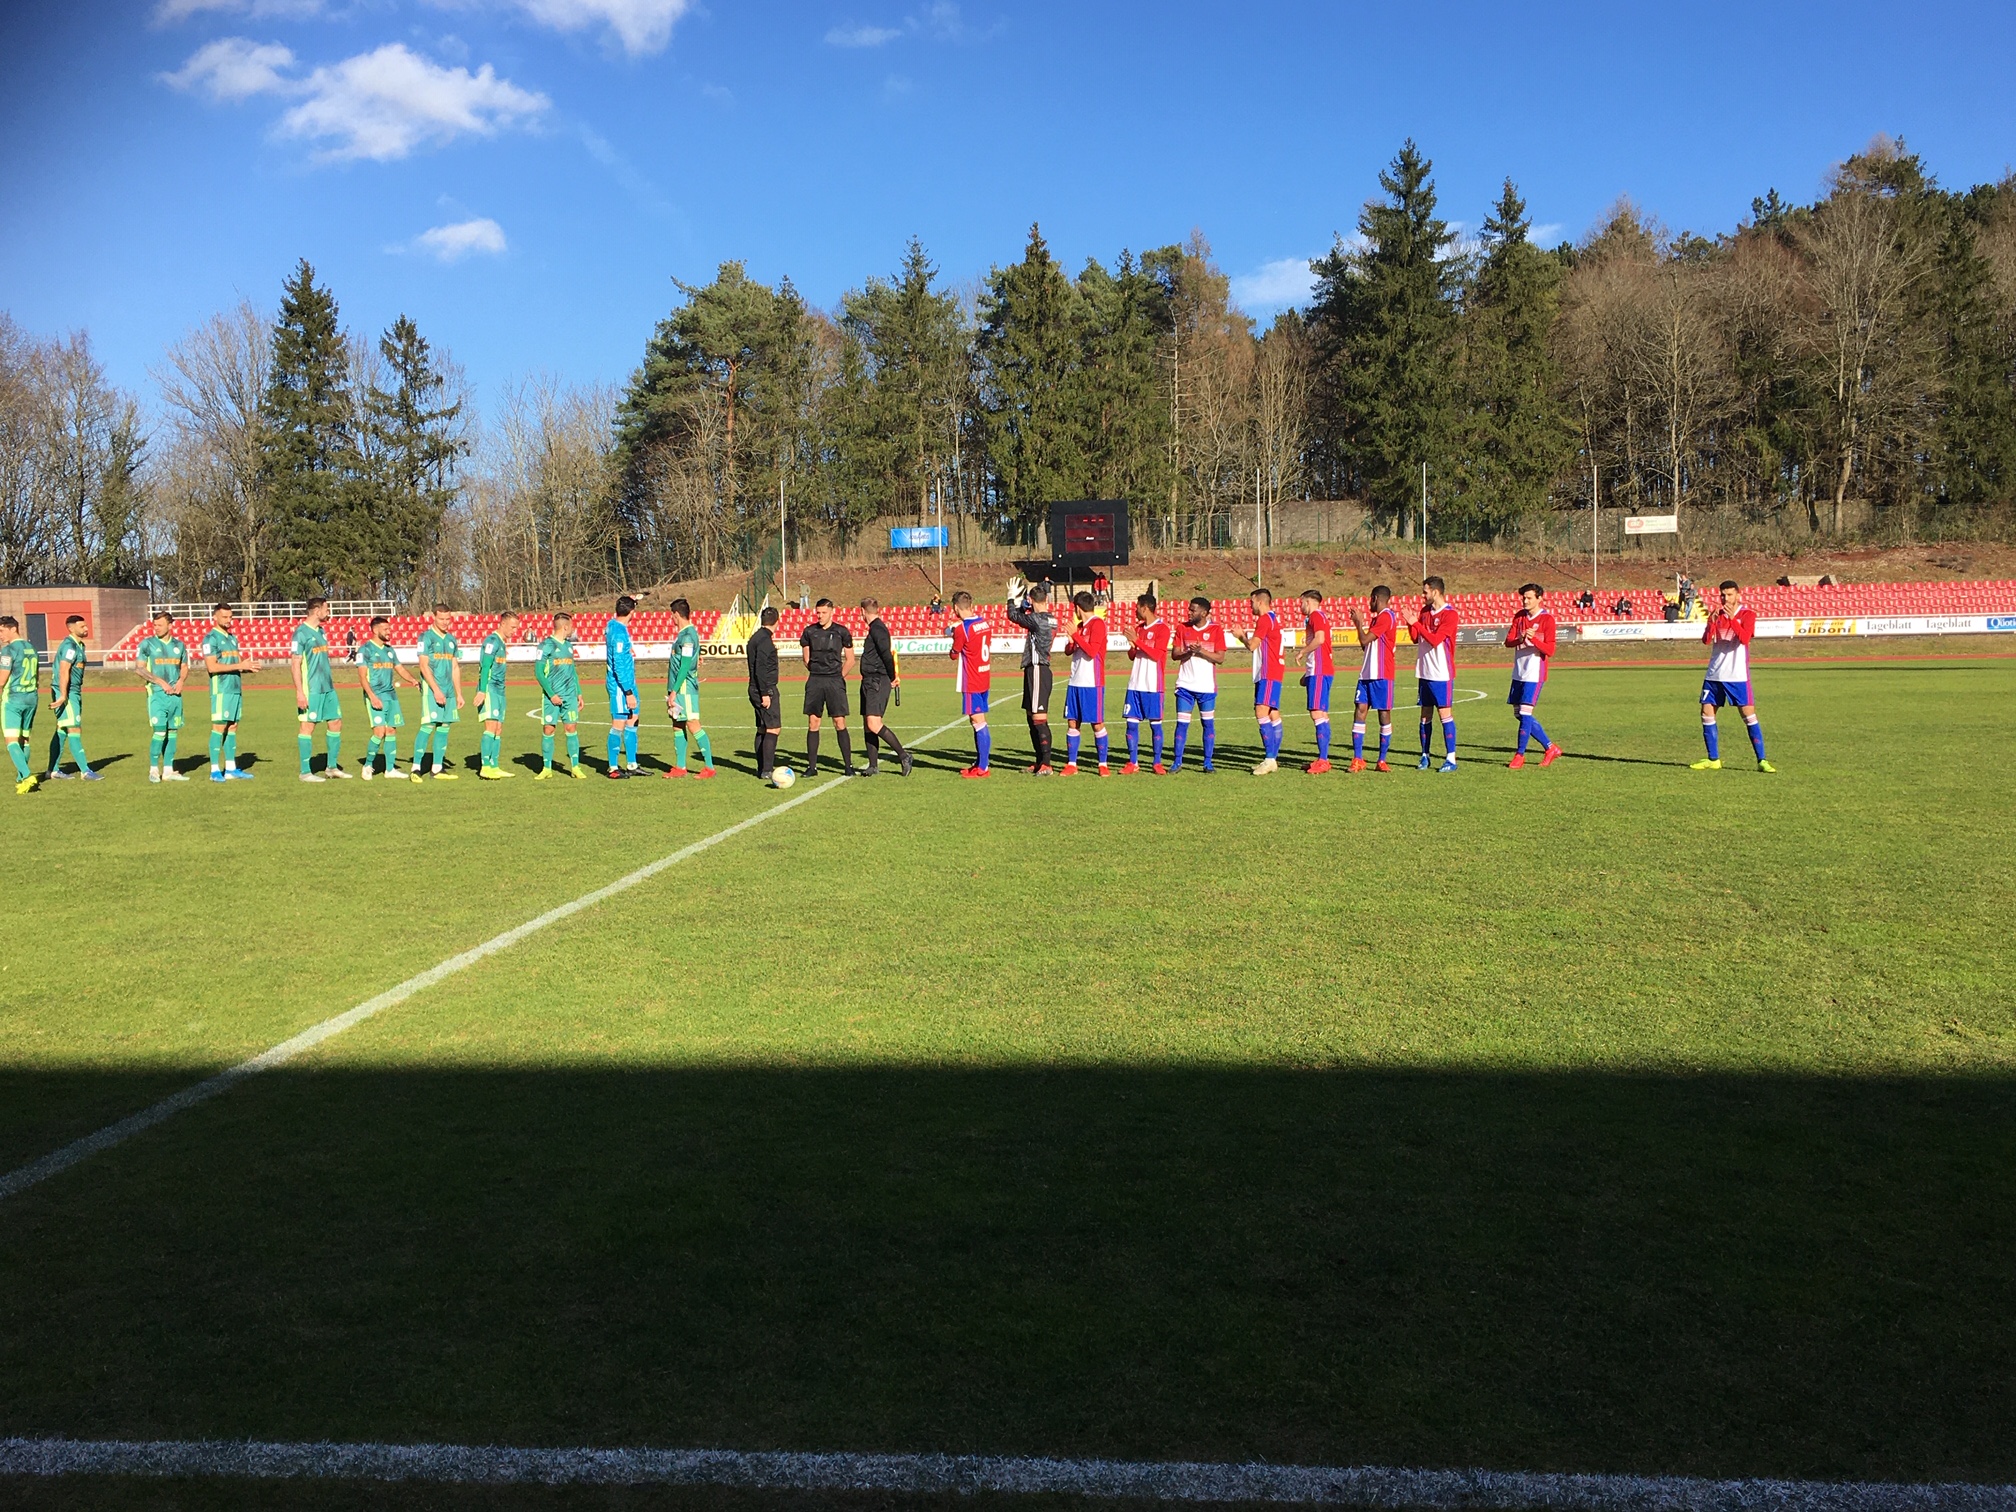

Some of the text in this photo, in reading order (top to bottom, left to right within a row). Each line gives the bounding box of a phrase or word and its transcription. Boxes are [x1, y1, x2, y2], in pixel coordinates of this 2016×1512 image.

[1798, 625, 1851, 634] oliboni
[907, 641, 953, 652] Cactus
[981, 635, 989, 662] 6
[1703, 689, 1710, 701] 7
